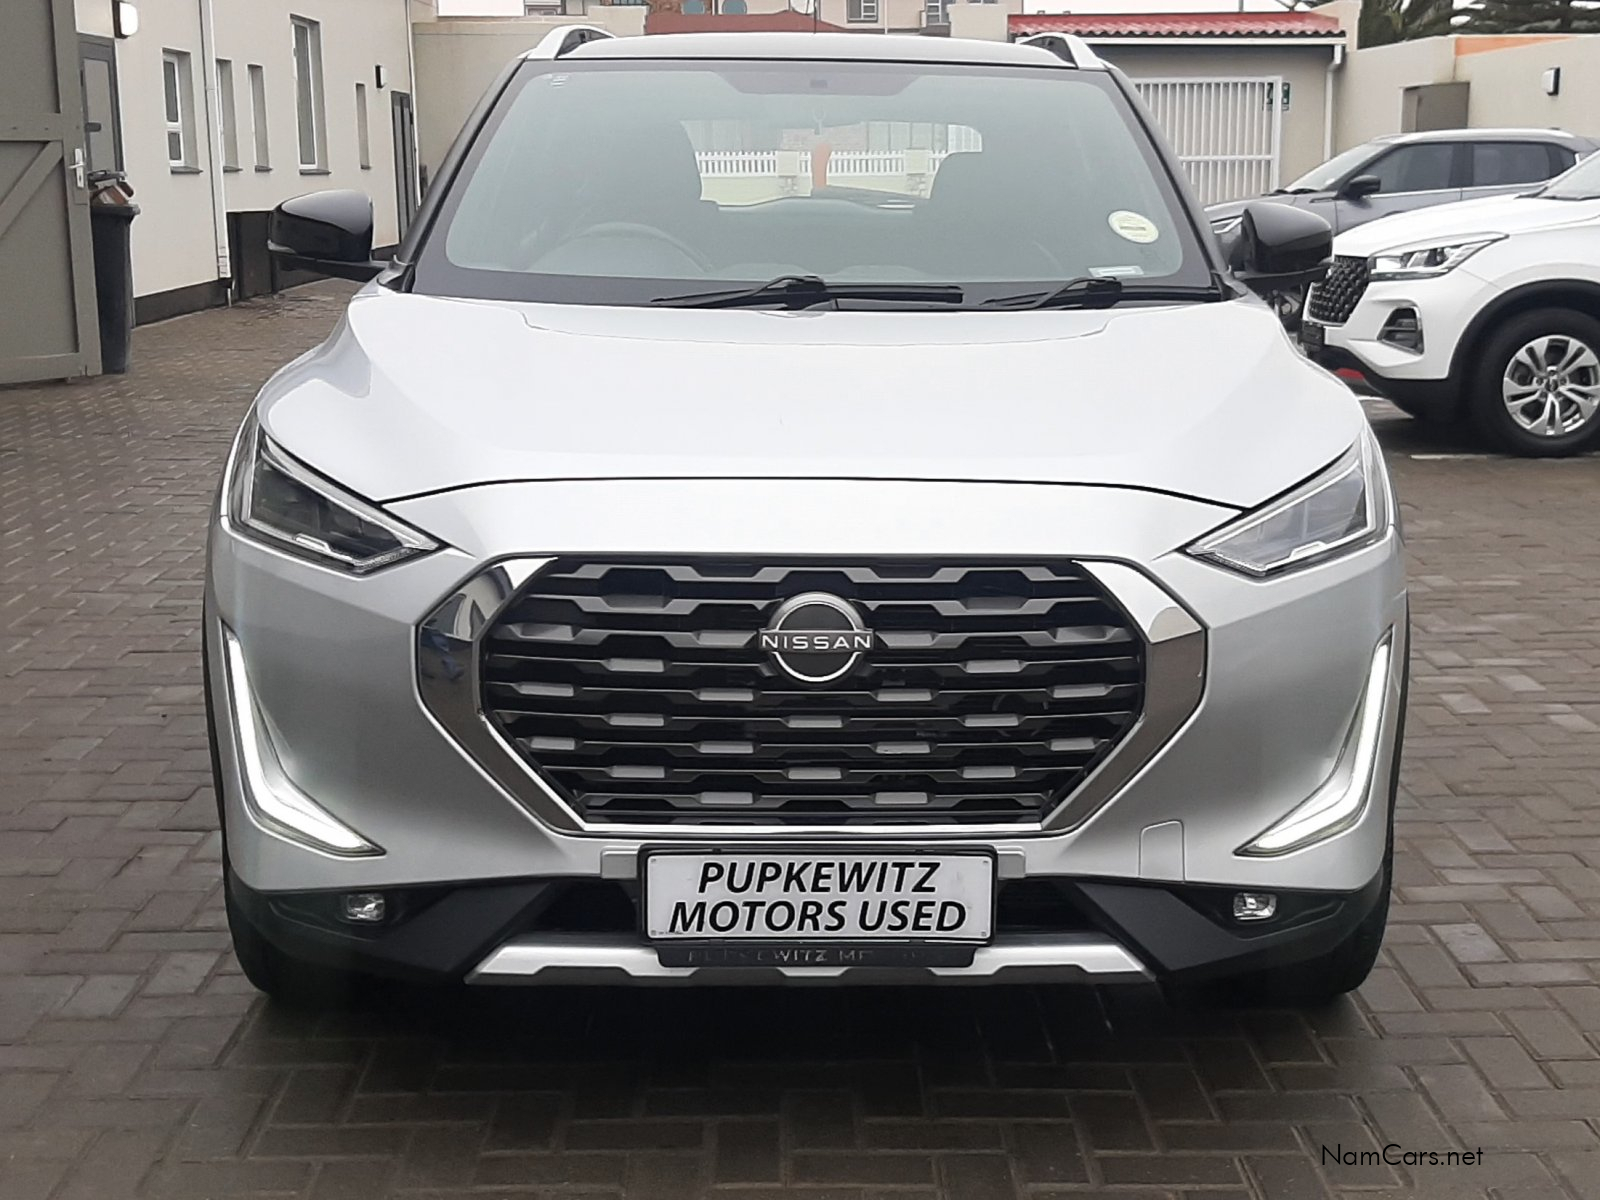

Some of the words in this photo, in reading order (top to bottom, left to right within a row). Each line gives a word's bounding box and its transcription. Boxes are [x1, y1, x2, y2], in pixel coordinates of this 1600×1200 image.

[762, 635, 871, 650] NISSAN
[698, 861, 941, 893] PUPKEWITZ
[669, 900, 846, 932] MOTORS
[858, 900, 966, 932] USED
